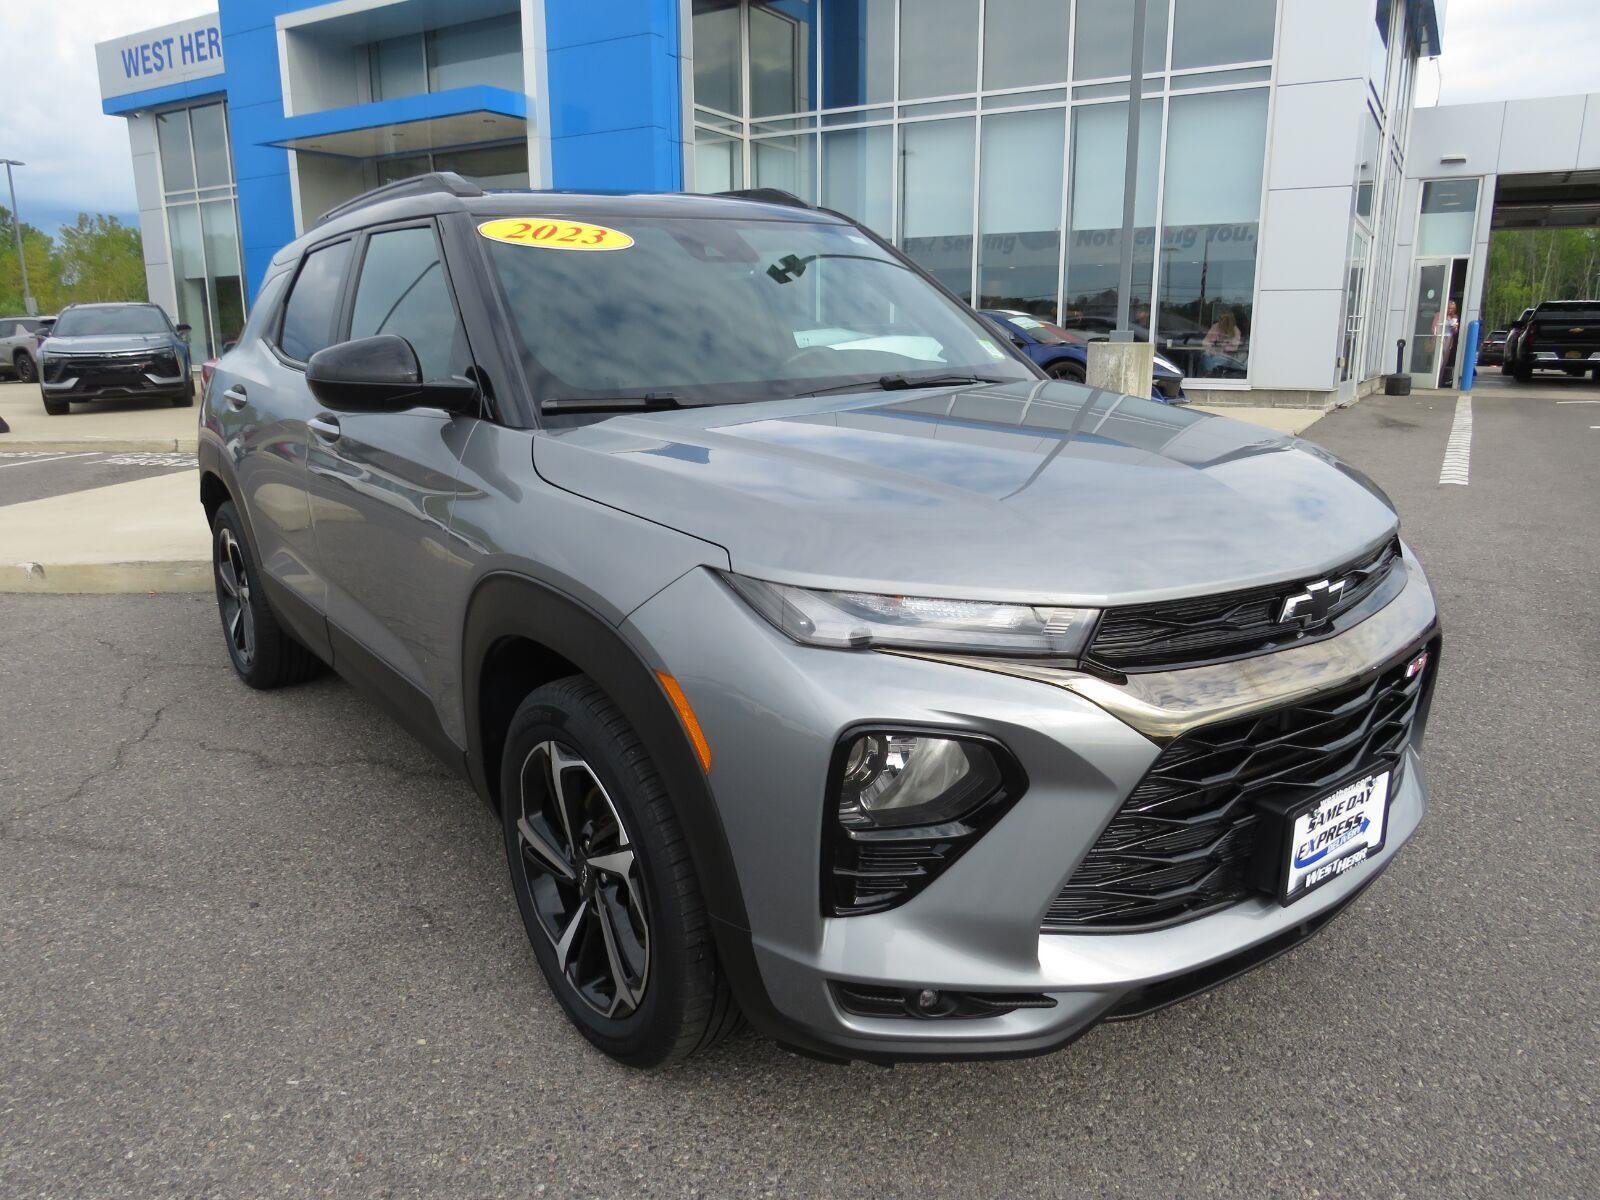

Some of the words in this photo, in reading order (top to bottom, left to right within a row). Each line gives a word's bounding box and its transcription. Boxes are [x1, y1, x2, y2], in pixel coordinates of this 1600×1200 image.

[121, 38, 174, 78] WEST
[180, 27, 221, 65] HER
[506, 223, 607, 244] 2023
[943, 234, 1015, 254] Sering
[1077, 229, 1115, 247] Not
[1307, 800, 1346, 833] SAME
[1346, 787, 1376, 811] DAY
[1297, 811, 1364, 860] EXPRESS
